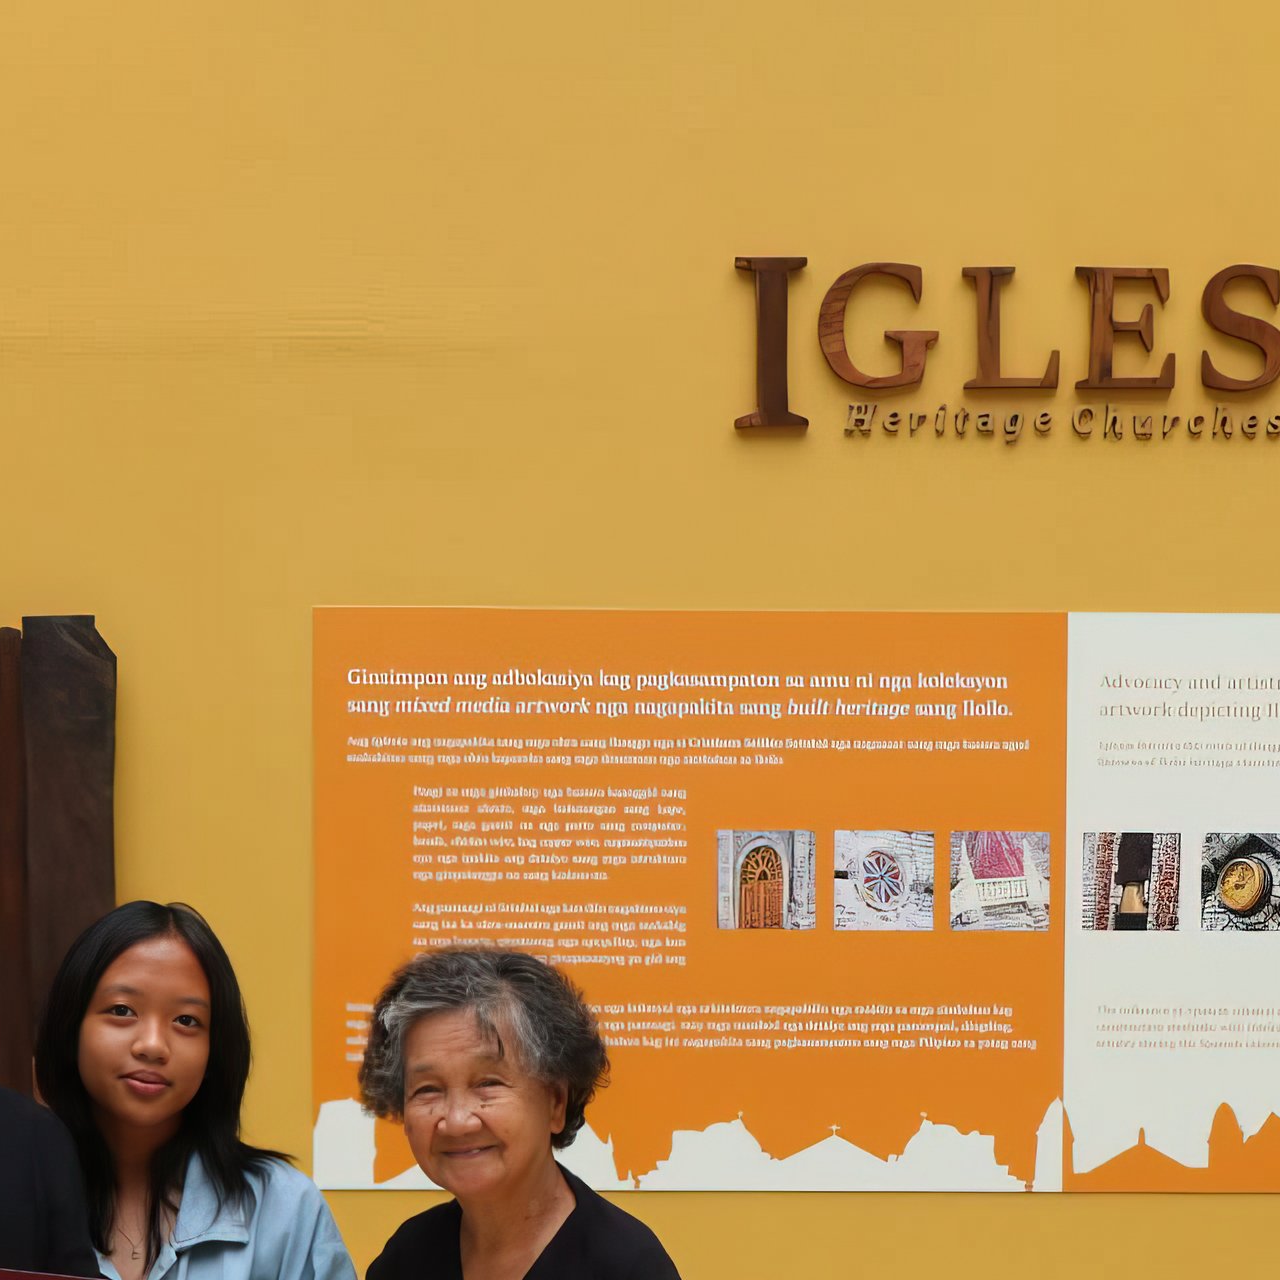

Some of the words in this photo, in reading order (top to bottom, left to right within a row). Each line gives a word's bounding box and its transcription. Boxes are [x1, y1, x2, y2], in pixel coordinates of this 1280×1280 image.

[844, 404, 1054, 446] Heritage
[453, 673, 487, 690] ang
[1099, 674, 1182, 693] Advocacy
[1188, 674, 1221, 691] and
[395, 697, 451, 713] mixed
[455, 697, 511, 714] media
[515, 697, 592, 714] artwork
[787, 698, 830, 715] built
[835, 698, 910, 719] heritage
[1099, 702, 1172, 718] artwork
[1177, 701, 1262, 721] depicting
